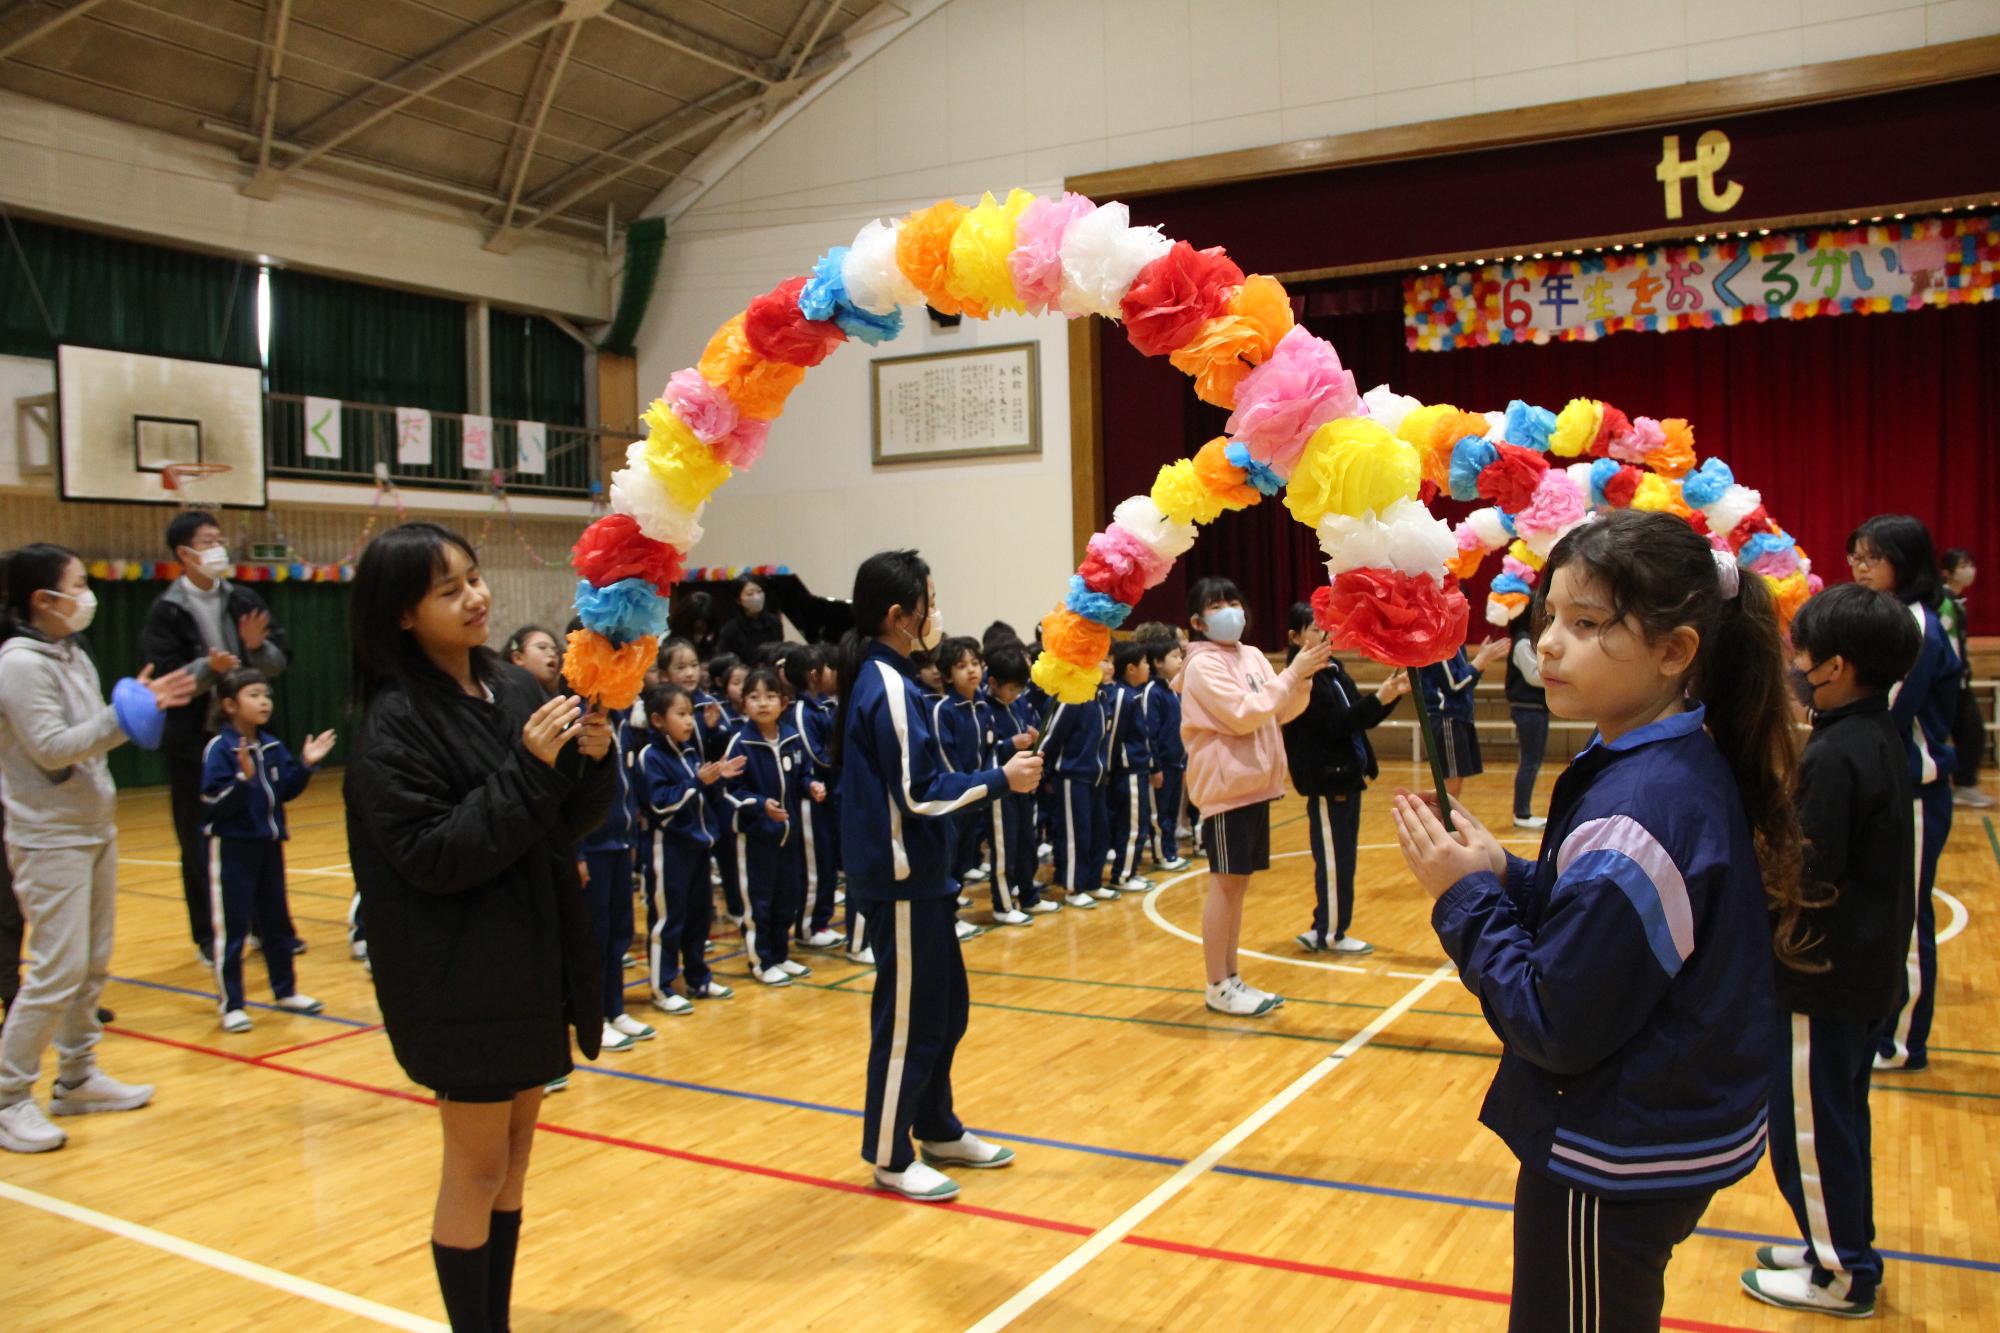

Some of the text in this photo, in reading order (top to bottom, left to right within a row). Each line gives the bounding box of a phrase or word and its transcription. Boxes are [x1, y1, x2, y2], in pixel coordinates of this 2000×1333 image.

[1501, 248, 1896, 329] 6年生をおくるかい
